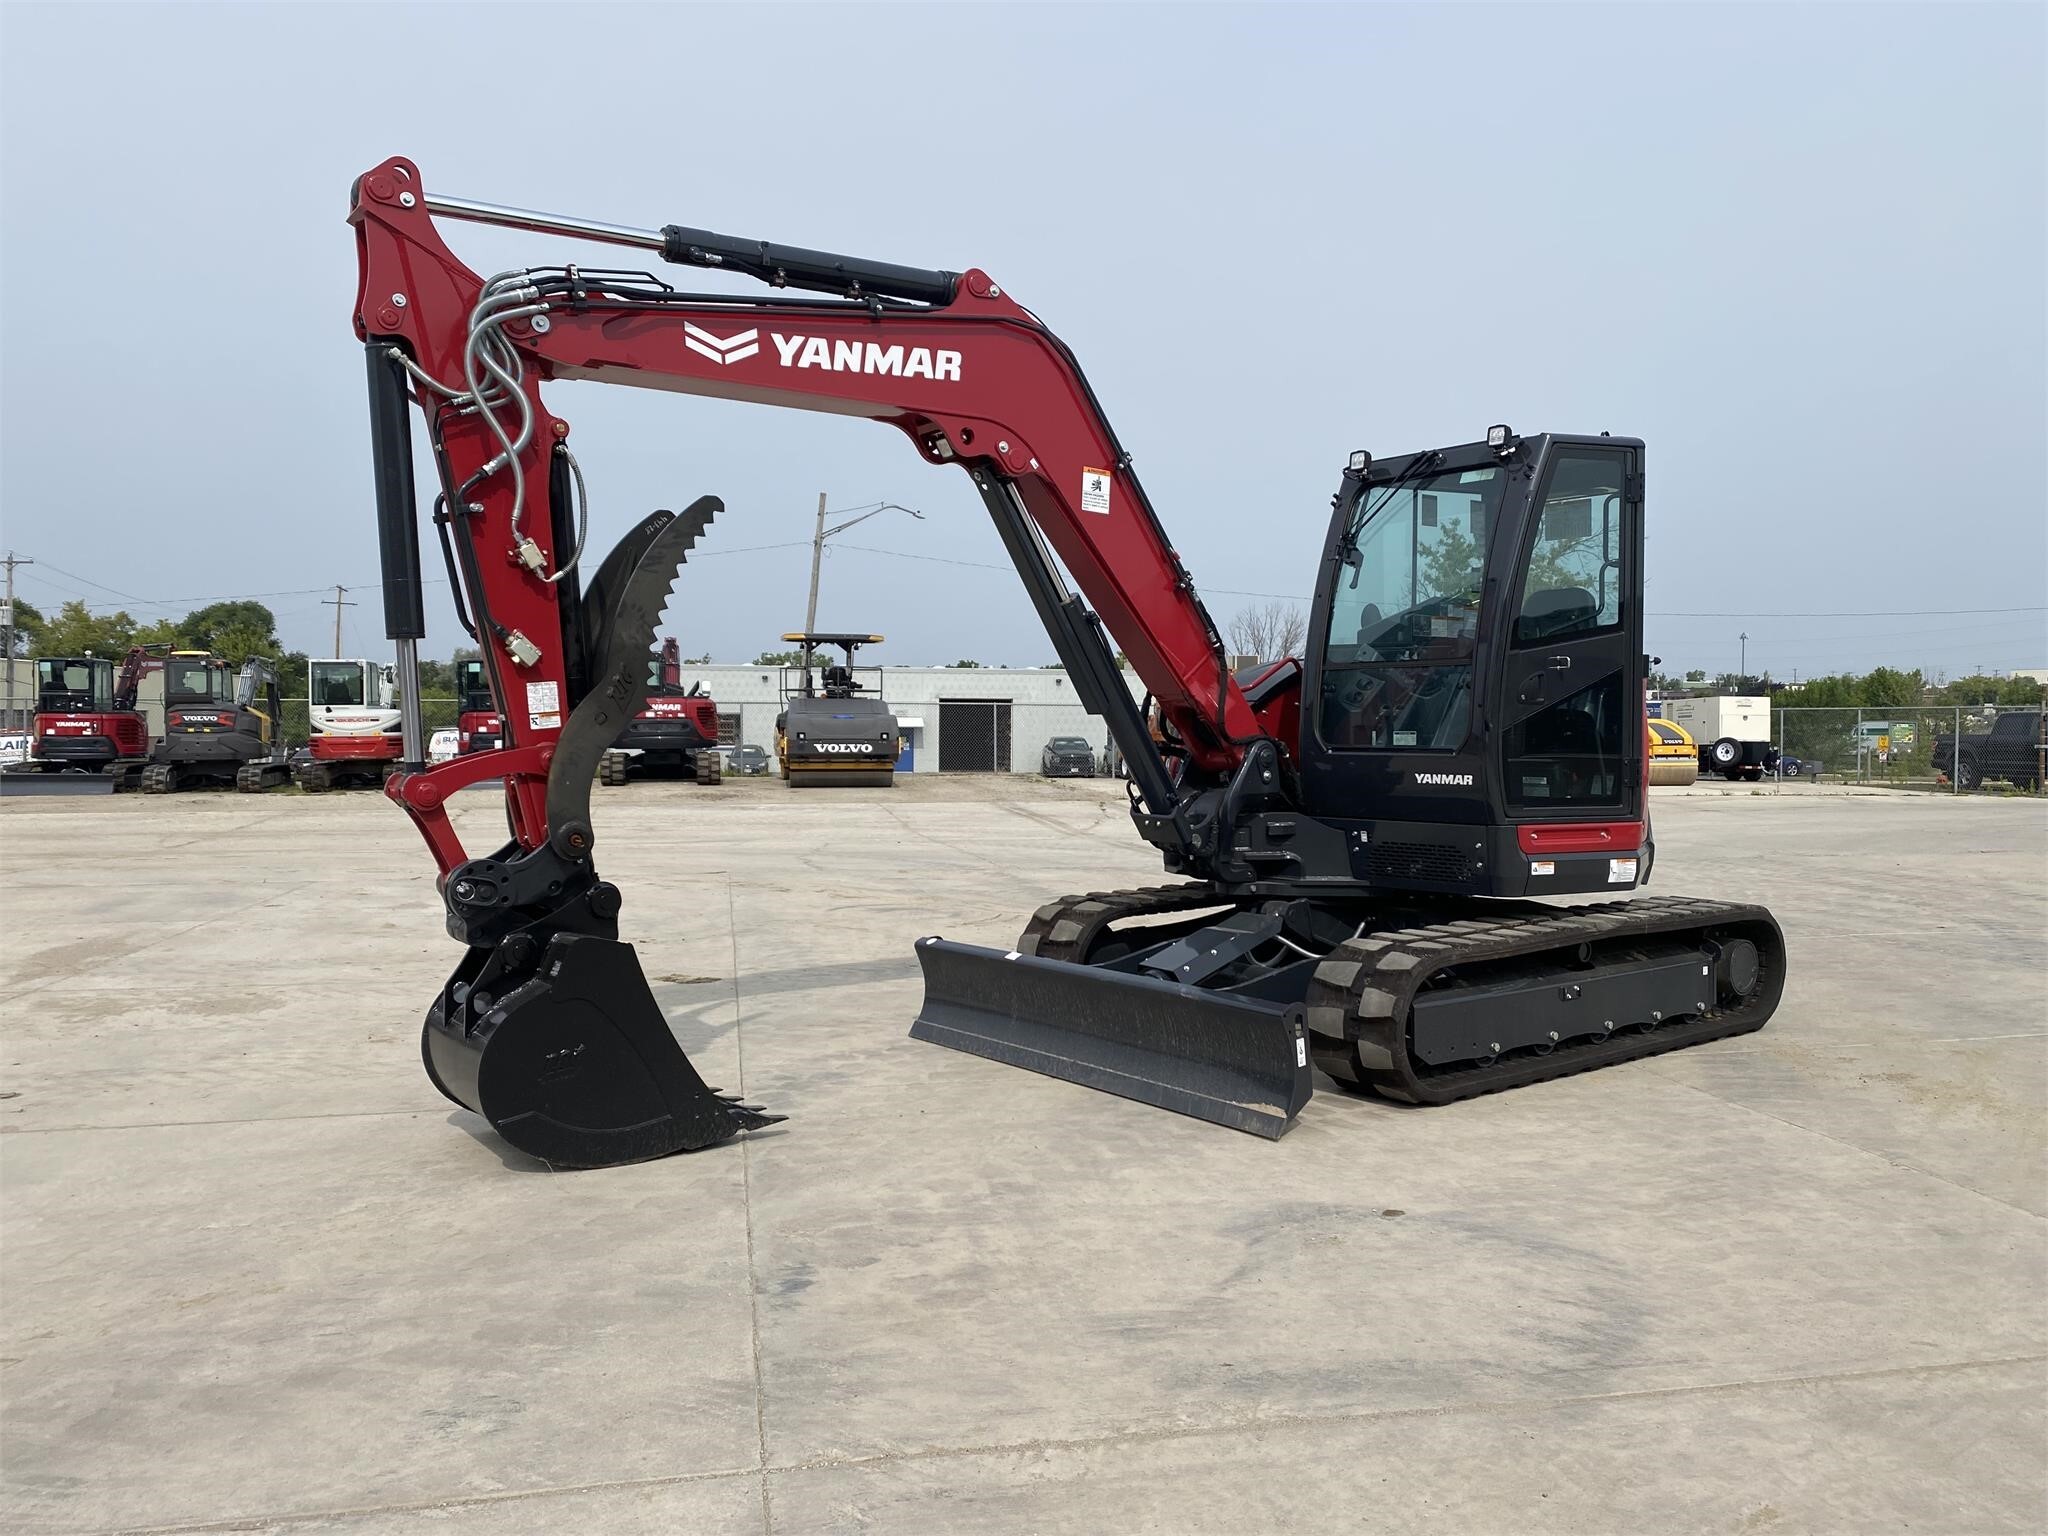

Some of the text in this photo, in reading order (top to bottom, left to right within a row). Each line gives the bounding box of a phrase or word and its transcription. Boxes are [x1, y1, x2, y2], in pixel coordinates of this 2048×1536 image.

[770, 333, 962, 381] YANMAR
[650, 703, 681, 711] NMAR
[813, 743, 873, 753] VOLVO
[1414, 773, 1473, 786] YANMAR
